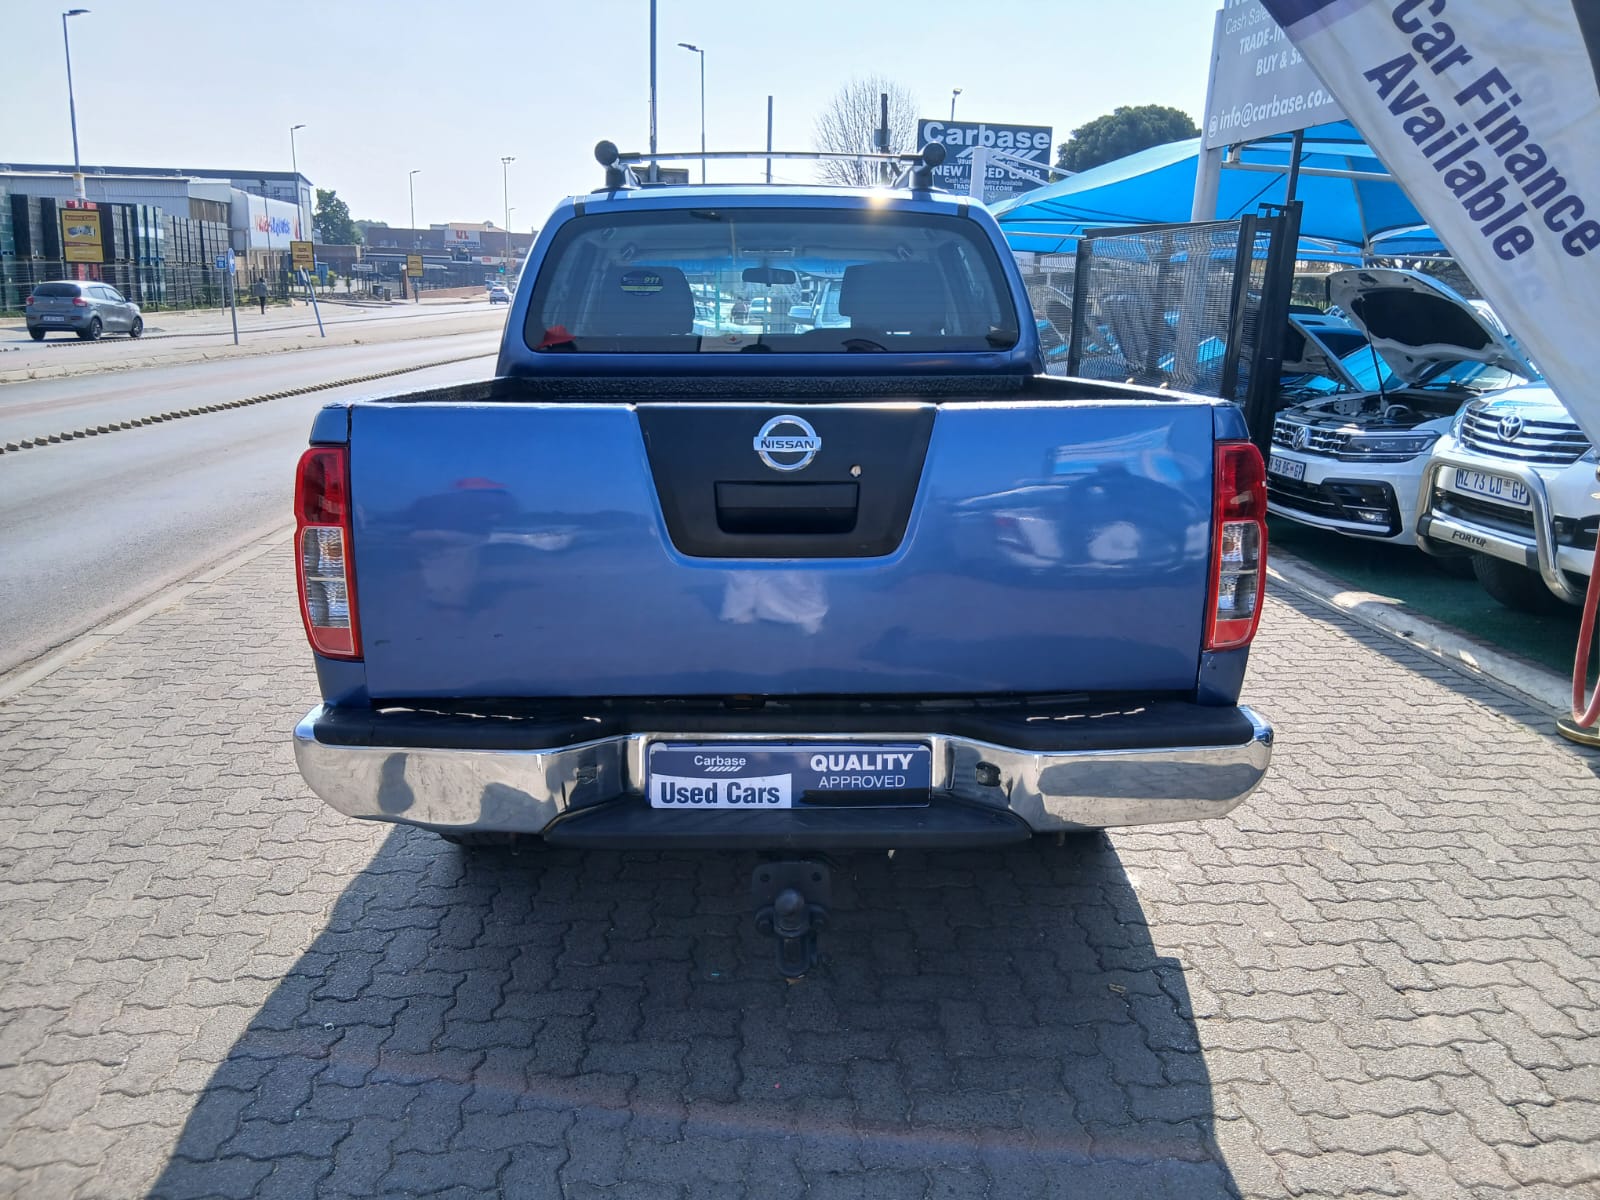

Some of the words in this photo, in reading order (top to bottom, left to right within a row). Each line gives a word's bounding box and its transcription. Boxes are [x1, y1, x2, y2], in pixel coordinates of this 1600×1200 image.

[1225, 11, 1247, 35] Cash
[1256, 53, 1278, 76] BUY
[1279, 50, 1288, 69] &
[923, 121, 1050, 149] Carbase
[1392, 0, 1473, 76] Car
[1453, 66, 1600, 257] Finance
[1362, 52, 1535, 261] Available
[931, 165, 963, 177] NEW
[760, 440, 815, 449] NISSAN
[1474, 472, 1486, 490] 73
[1489, 476, 1503, 495] LD
[1511, 481, 1527, 500] GP
[694, 755, 746, 766] Carbase
[810, 753, 913, 772] QUALITY
[660, 782, 718, 804] Used
[726, 782, 780, 804] Cars
[818, 775, 906, 788] APPROVED
